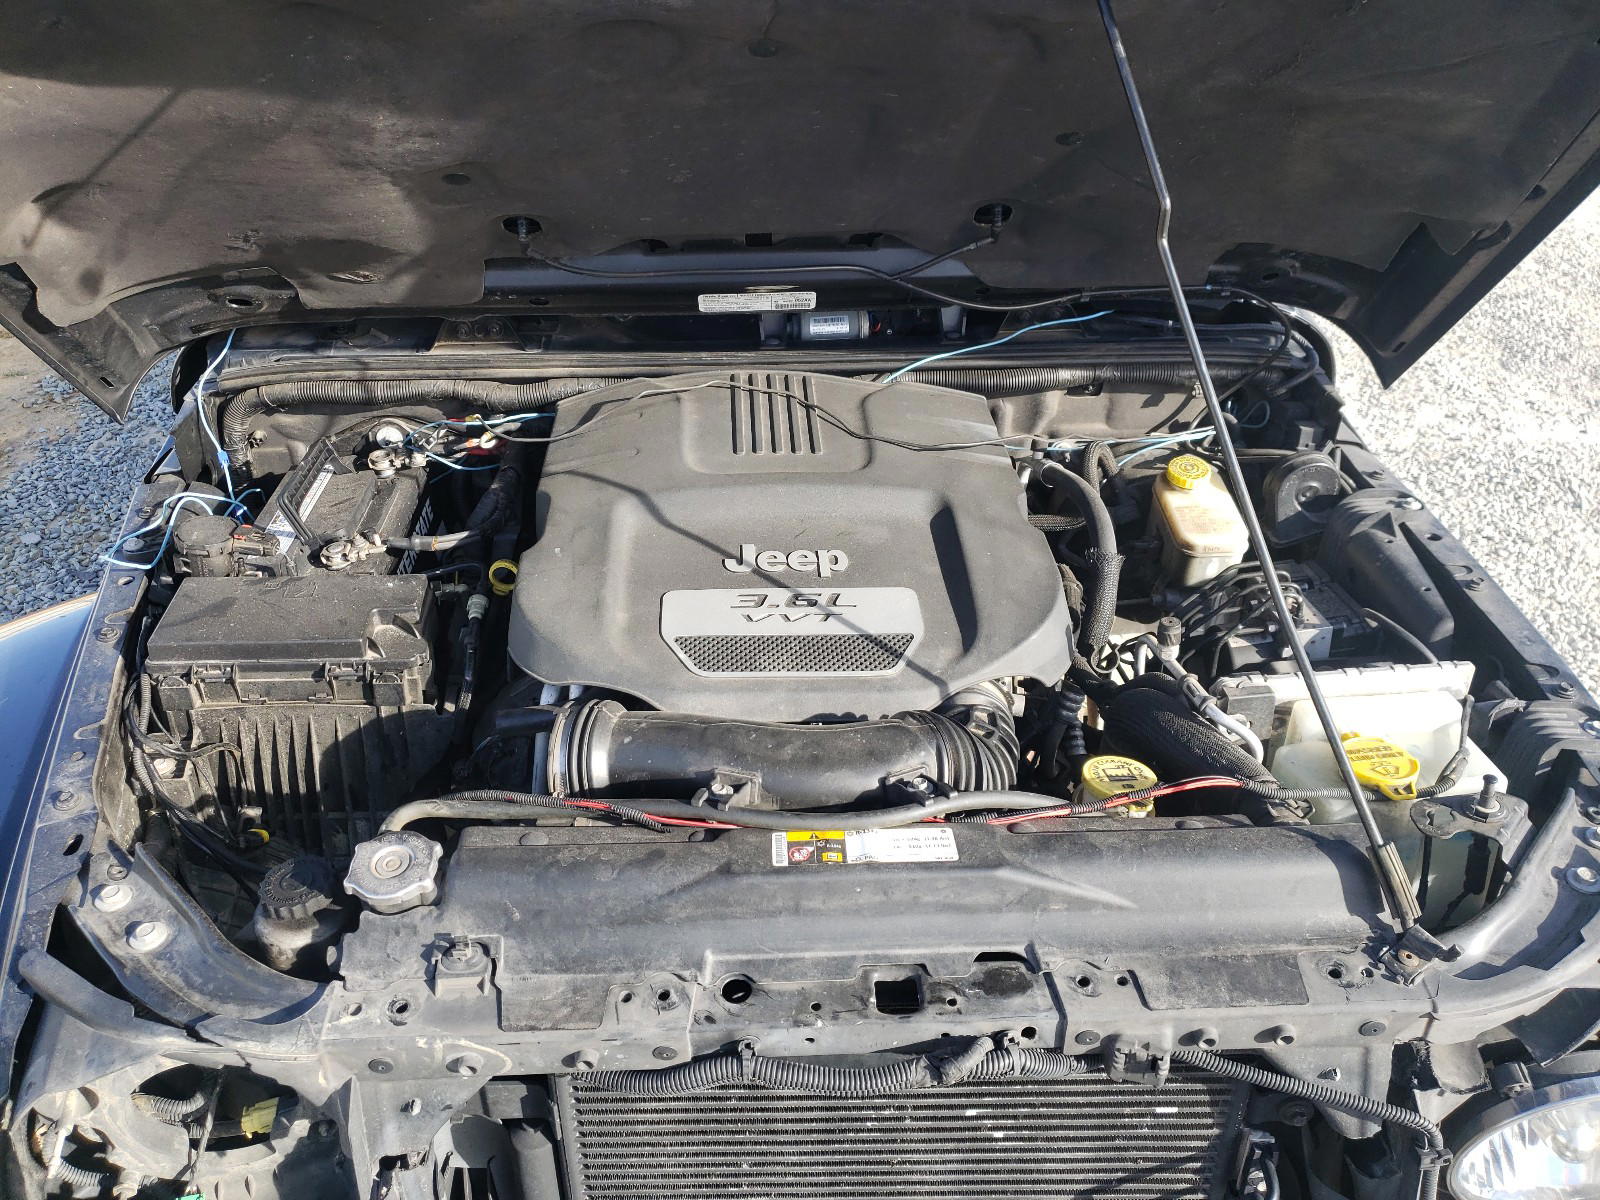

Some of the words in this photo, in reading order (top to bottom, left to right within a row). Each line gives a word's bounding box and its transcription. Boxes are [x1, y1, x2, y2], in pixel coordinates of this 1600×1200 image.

[722, 543, 849, 577] Jeep
[730, 592, 857, 609] 3.6L
[740, 612, 843, 623] VVT
